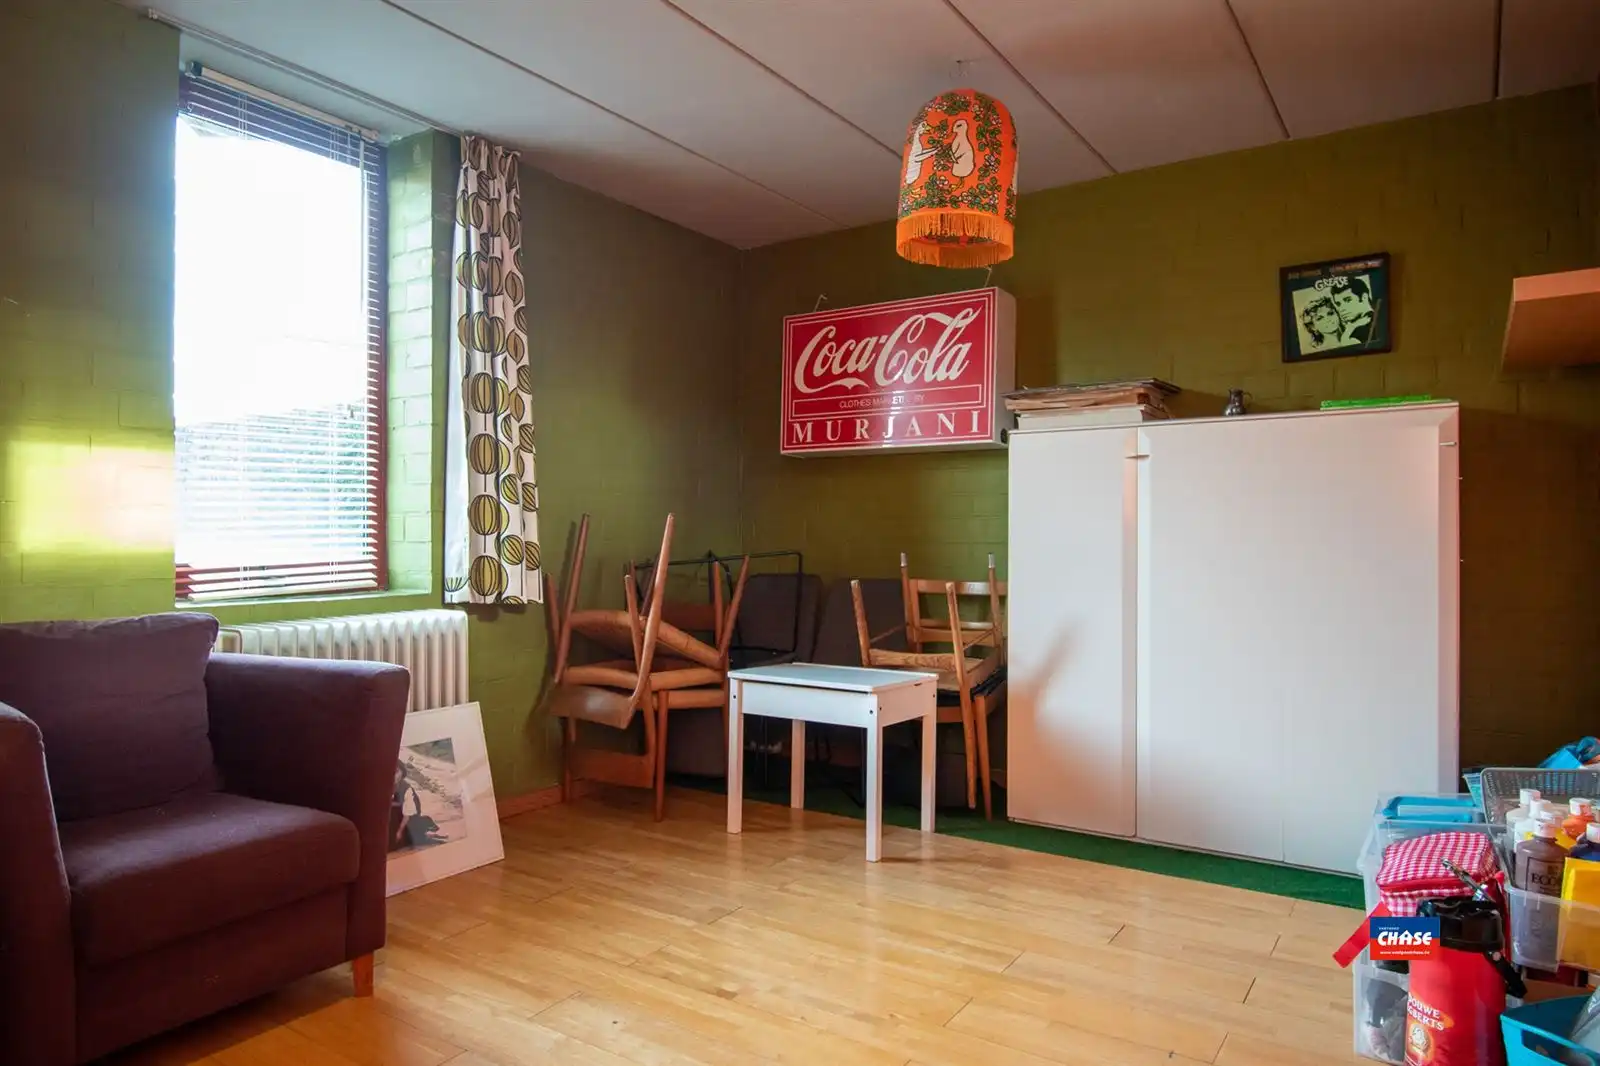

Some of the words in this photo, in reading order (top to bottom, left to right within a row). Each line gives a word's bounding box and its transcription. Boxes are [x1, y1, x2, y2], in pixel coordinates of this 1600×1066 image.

[1314, 276, 1349, 291] GREASE
[794, 305, 983, 394] Coca-Cola
[839, 398, 872, 408] CLOTHES
[791, 410, 980, 443] MURJANI
